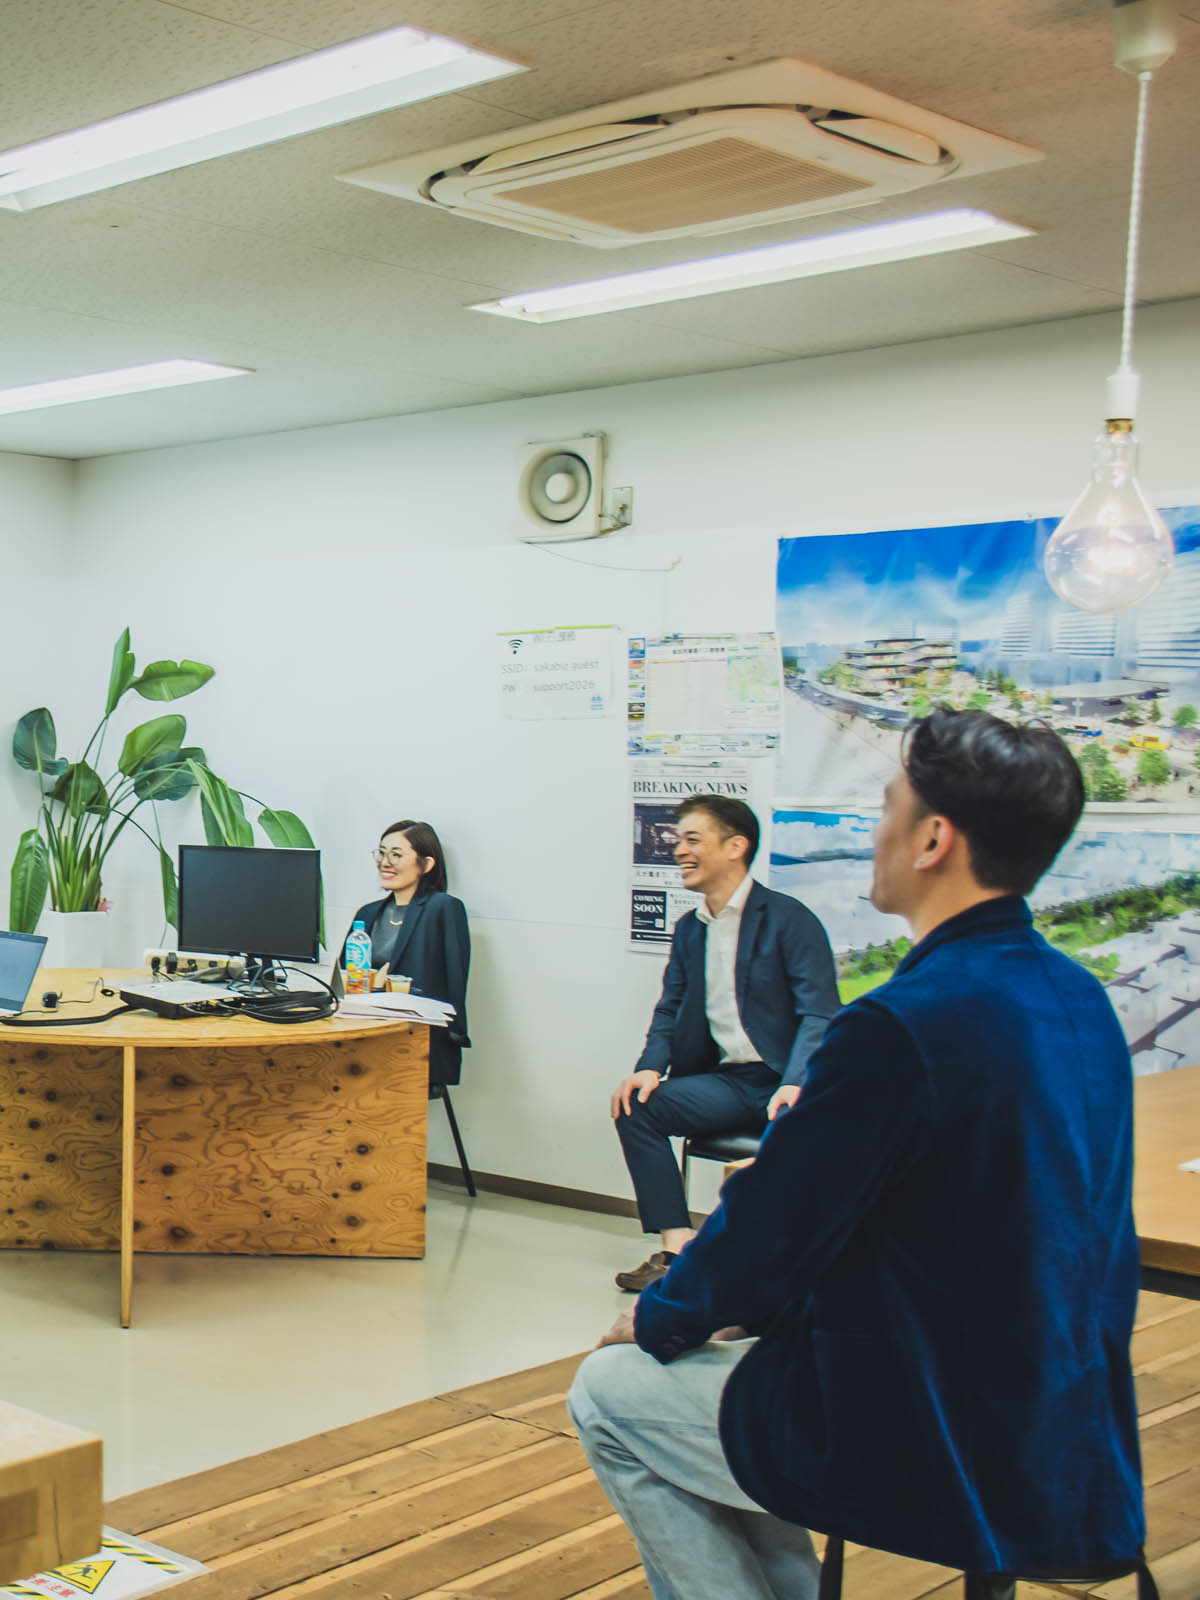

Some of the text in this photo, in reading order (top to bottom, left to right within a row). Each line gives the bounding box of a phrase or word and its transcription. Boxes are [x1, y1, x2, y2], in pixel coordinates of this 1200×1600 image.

[633, 781, 748, 794] BREAKING NEWS
[633, 894, 664, 903] COMING
[633, 903, 664, 914] SOON
